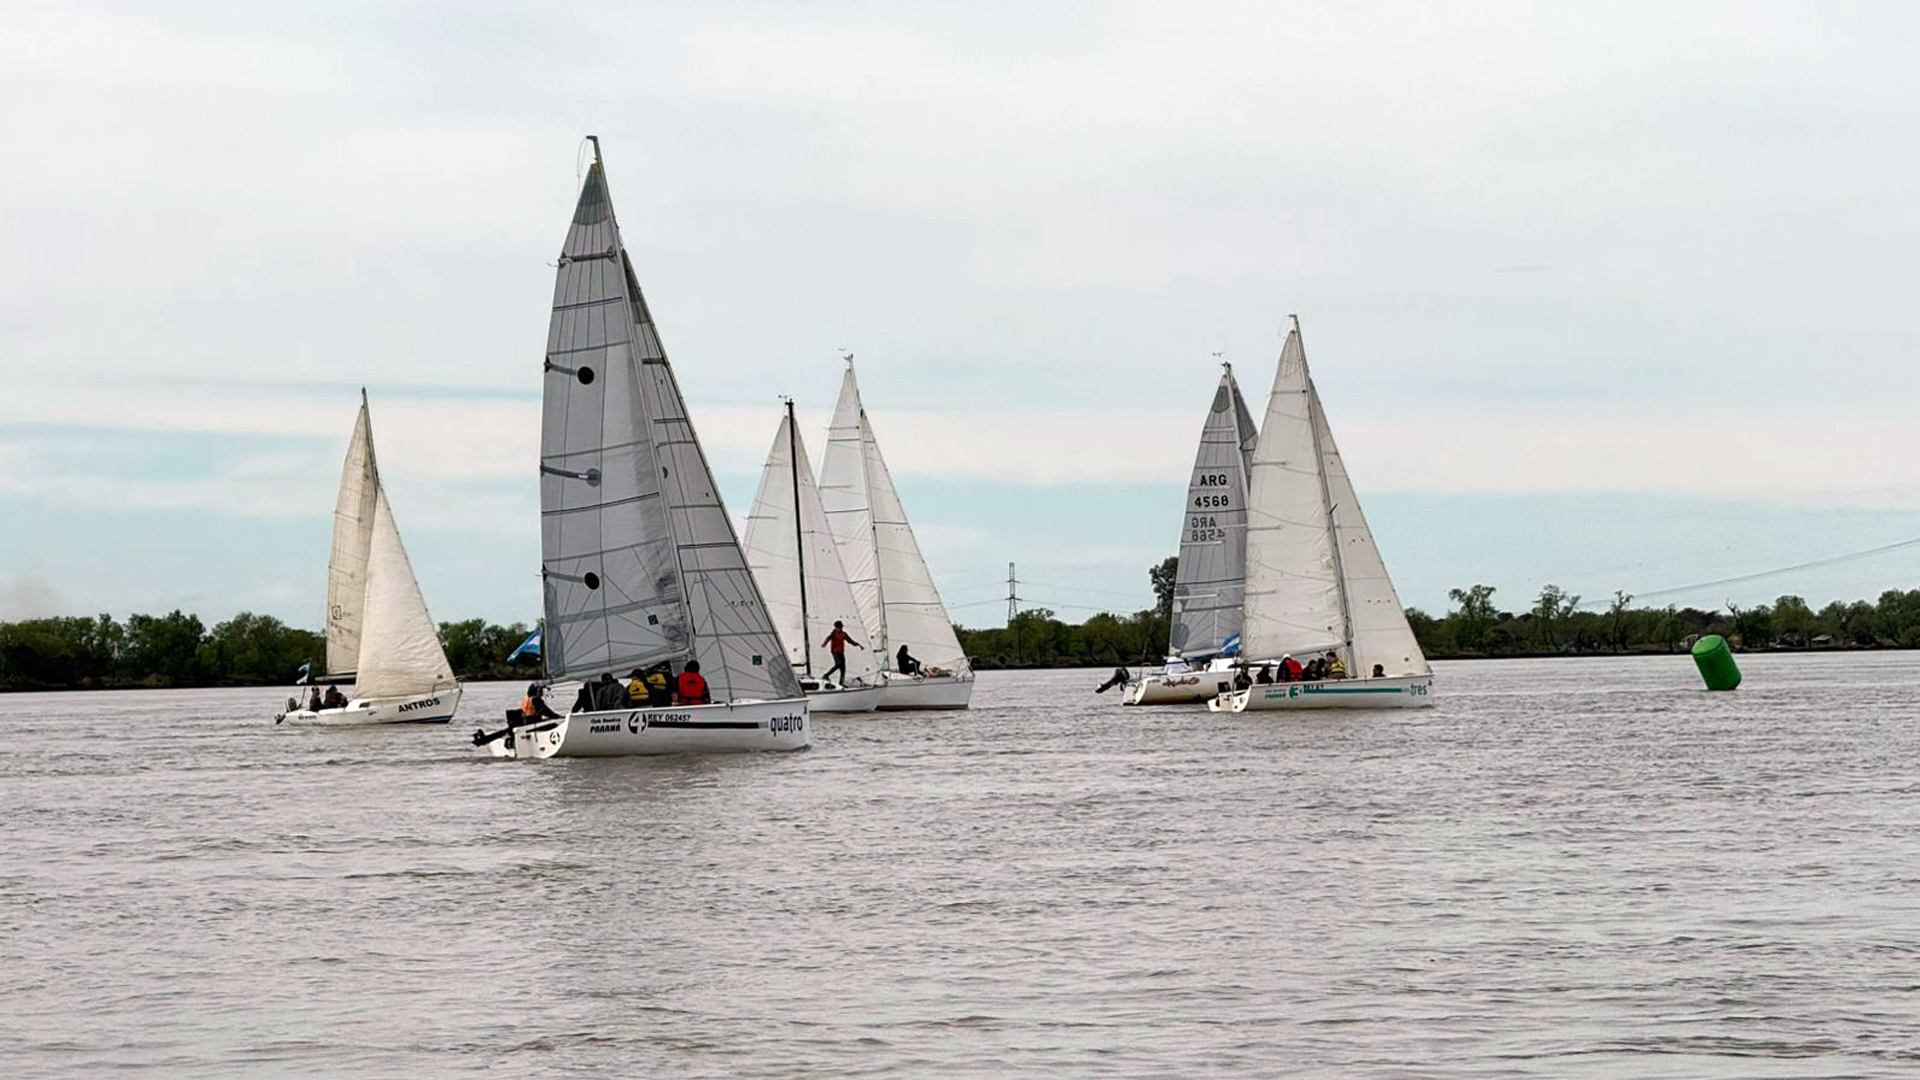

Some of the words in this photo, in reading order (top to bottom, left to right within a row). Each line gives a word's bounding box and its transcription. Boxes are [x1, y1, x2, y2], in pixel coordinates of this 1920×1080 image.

[1200, 474, 1227, 487] ARG
[1194, 495, 1229, 508] 4568
[398, 697, 441, 713] ANTROS
[770, 712, 803, 737] quatro
